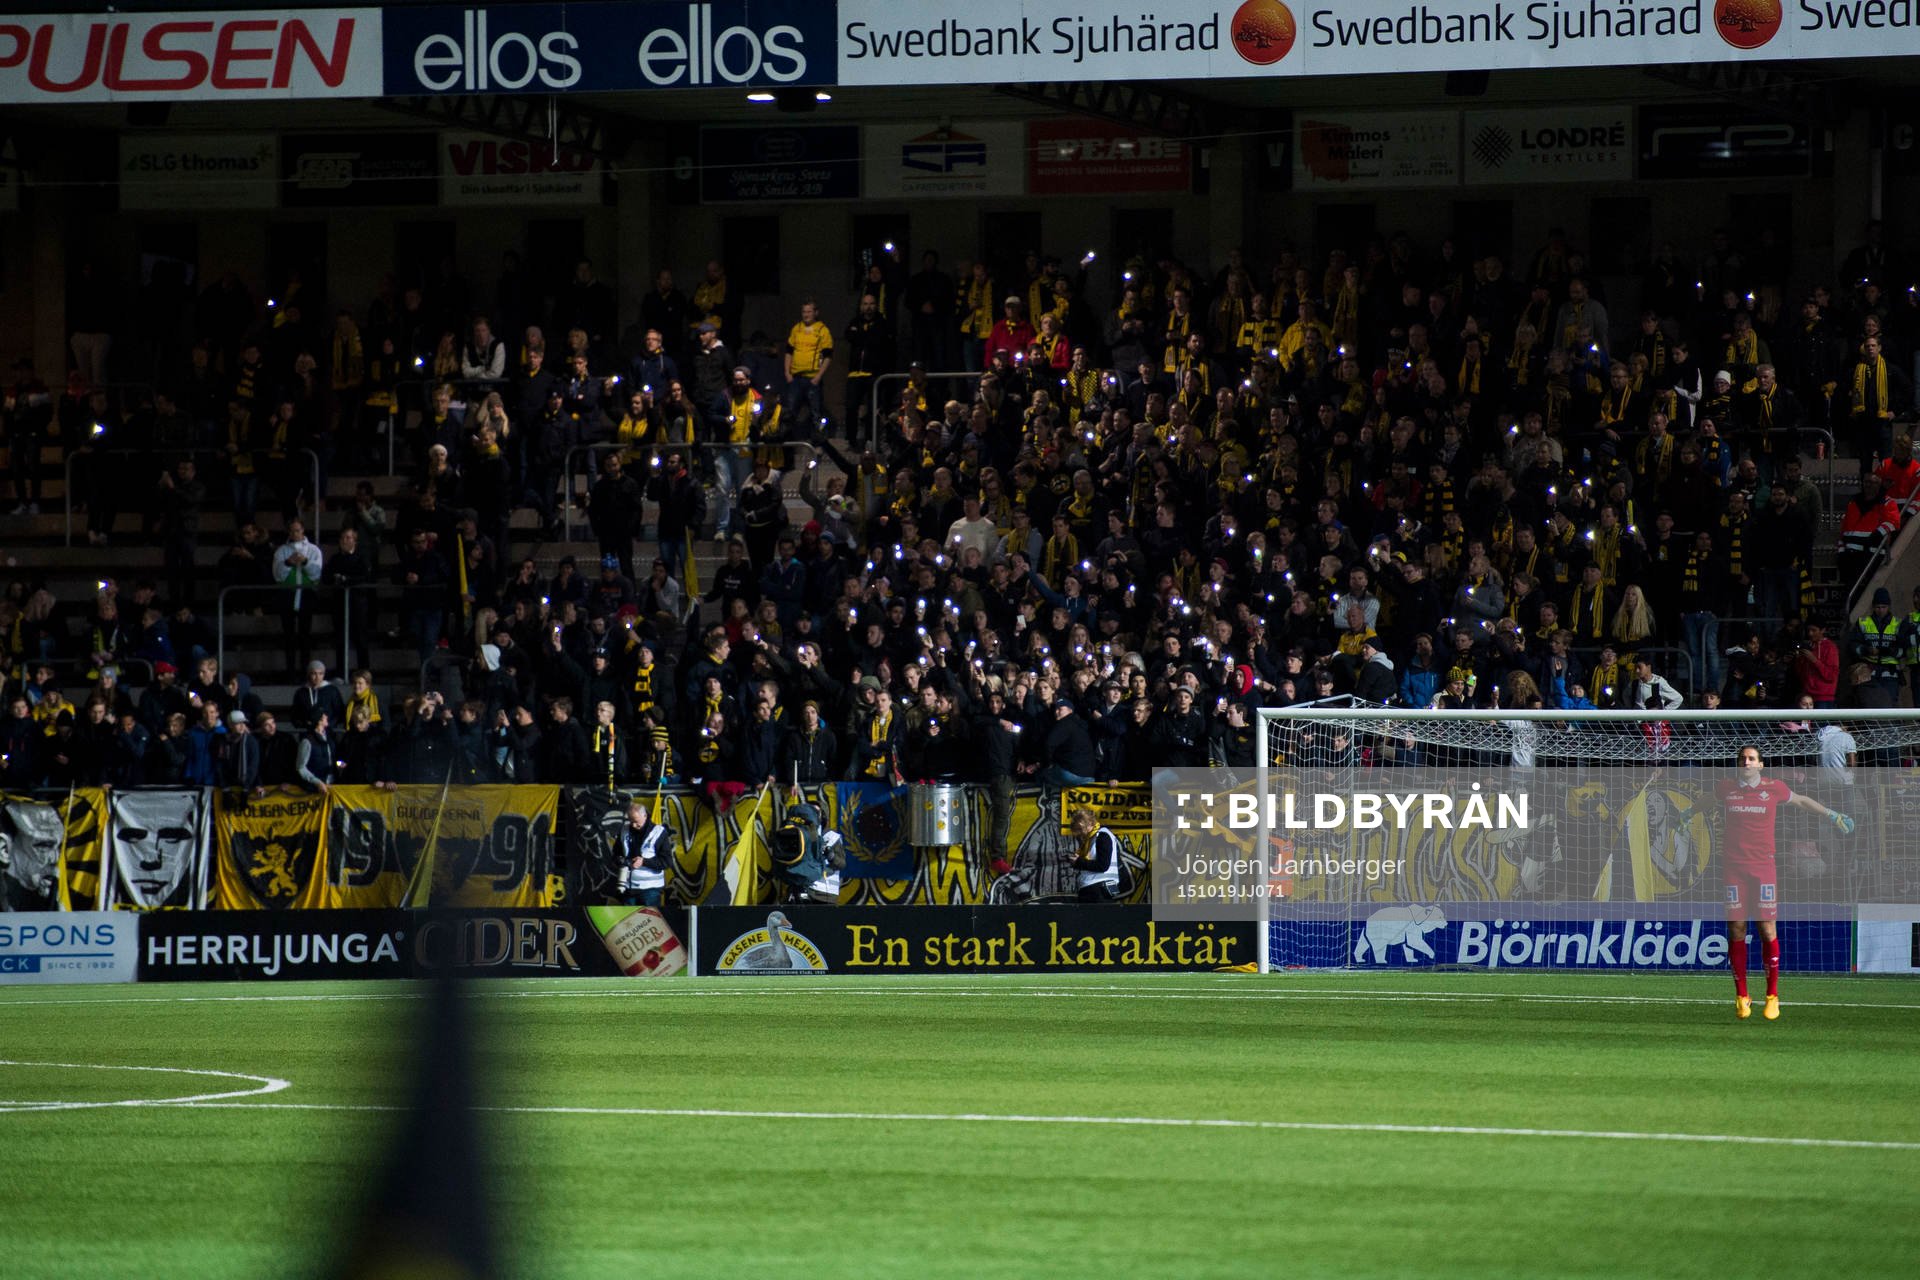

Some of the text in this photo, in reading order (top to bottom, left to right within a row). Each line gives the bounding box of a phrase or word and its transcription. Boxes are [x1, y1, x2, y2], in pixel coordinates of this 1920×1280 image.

[1313, 0, 1701, 48] Swedbank Sjuhärad
[1800, 0, 1920, 30] Swed
[414, 10, 582, 91] ellos
[638, 4, 807, 85] ellos
[846, 13, 1219, 63] Swedbank Sjuhärad
[1056, 137, 1164, 161] PEAB
[1320, 128, 1391, 143] Kimmos
[1521, 121, 1625, 149] LONDRÉ
[140, 153, 259, 170] SLG thomas
[1328, 145, 1384, 160] Måleri
[1531, 152, 1617, 163] TEXTILES
[397, 806, 481, 820] GULIGAERNA
[1729, 805, 1767, 813] HOLMEN
[328, 805, 386, 886] 19
[491, 813, 550, 892] 91
[0, 925, 115, 947] SPONS
[415, 917, 581, 970] CIDER
[614, 918, 652, 945] HERRLJUNGA
[620, 926, 664, 960] CIDER
[845, 920, 1238, 966] En stark karaktär
[1457, 919, 1752, 970] Björnkläde
[148, 932, 399, 976] HERRLJUNGA
[725, 933, 819, 966] GÄSENE MEJERI
